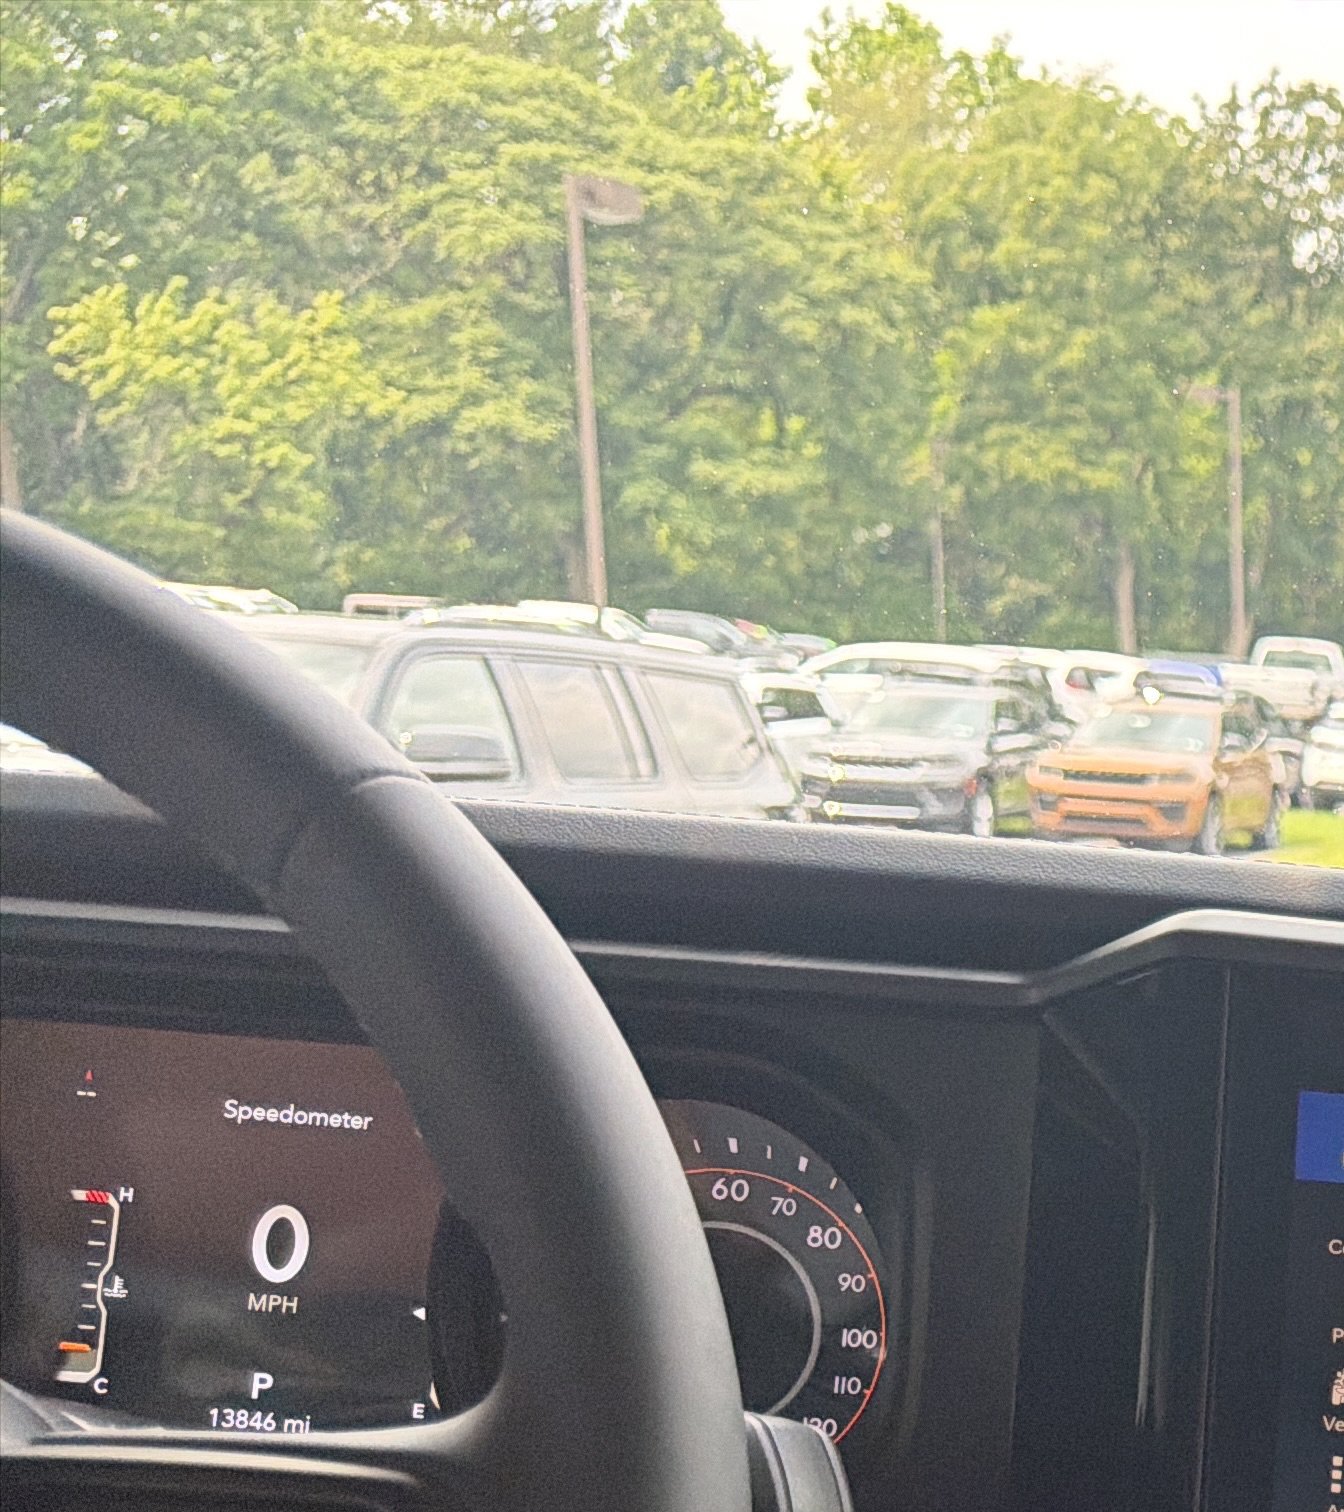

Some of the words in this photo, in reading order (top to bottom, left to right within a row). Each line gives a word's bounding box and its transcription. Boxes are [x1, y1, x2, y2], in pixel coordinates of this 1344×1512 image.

[224, 1100, 373, 1131] Speedometer
[119, 1188, 134, 1203] H
[711, 1178, 750, 1202] 60
[771, 1196, 797, 1218] 70
[252, 1204, 310, 1283] 0
[806, 1226, 842, 1250] 80
[838, 1273, 866, 1294] 90
[248, 1294, 298, 1314] MPH
[842, 1328, 878, 1350] 100
[94, 1378, 108, 1394] C
[251, 1373, 273, 1400] P
[834, 1376, 862, 1394] 110
[210, 1408, 276, 1432] 13846
[284, 1415, 311, 1434] mi
[413, 1404, 424, 1419] E
